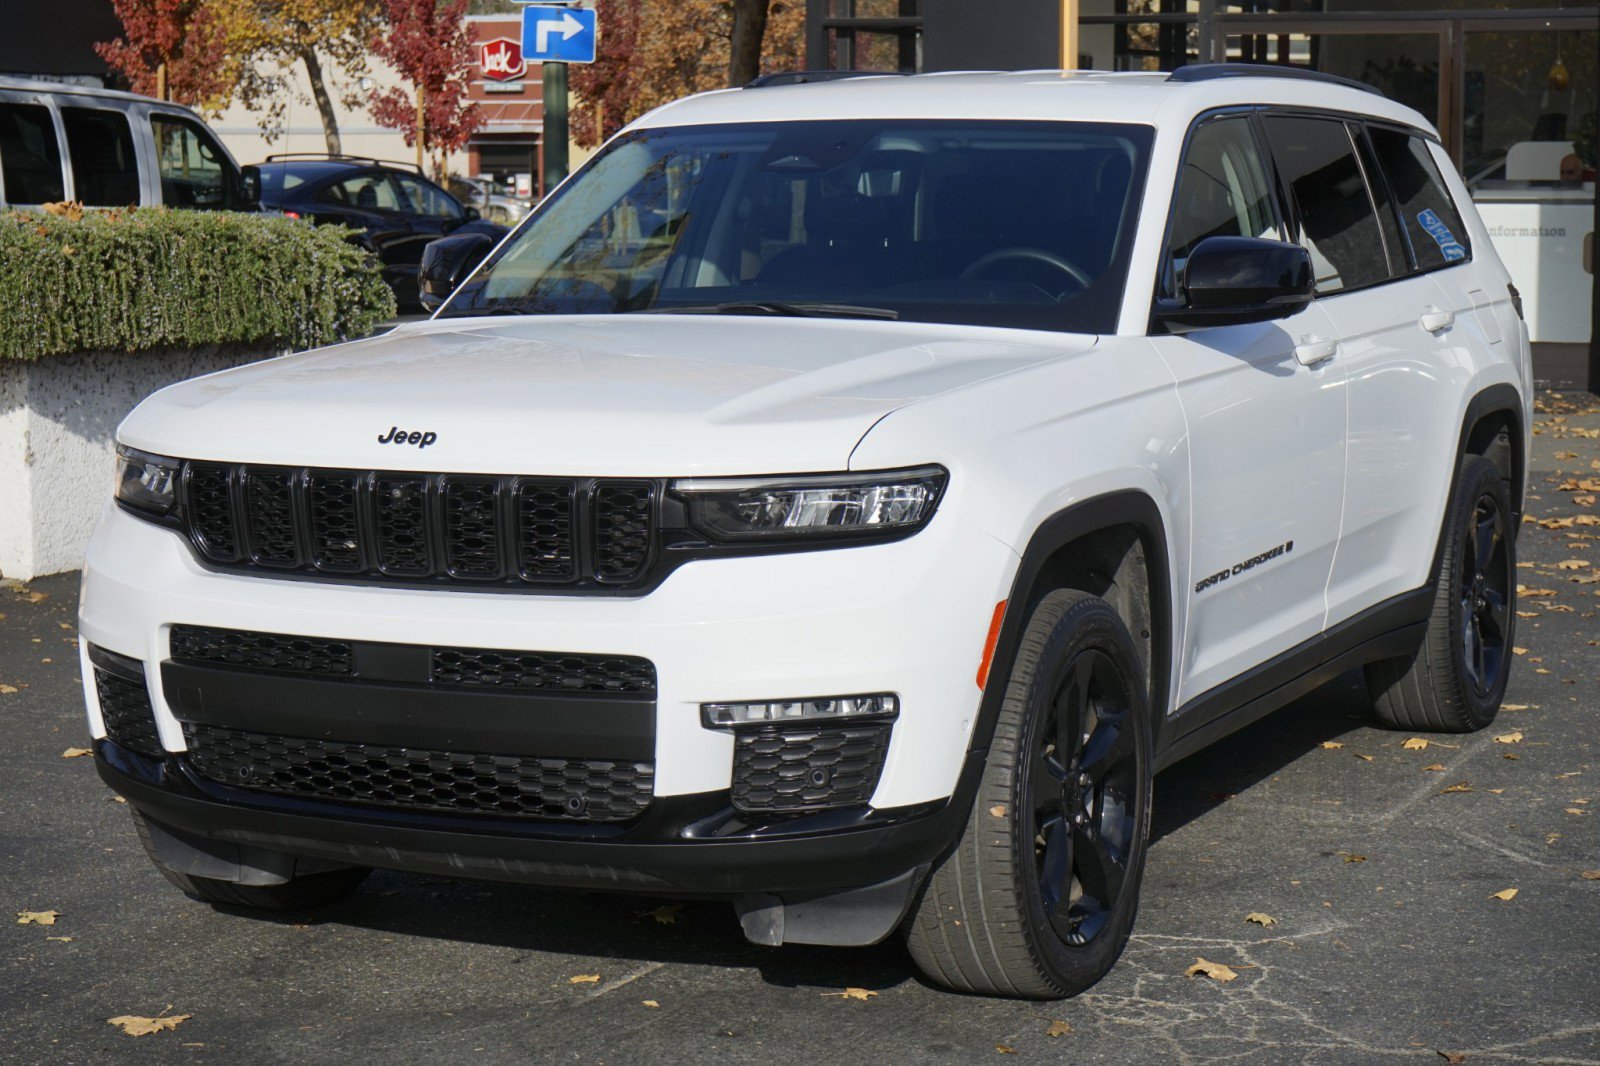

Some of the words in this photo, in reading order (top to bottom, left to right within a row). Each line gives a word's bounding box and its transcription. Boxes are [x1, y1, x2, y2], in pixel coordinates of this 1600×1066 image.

[482, 42, 522, 73] Jack
[1488, 225, 1566, 237] nformation
[378, 426, 437, 449] Jeep
[1195, 568, 1231, 593] GRAND
[1231, 543, 1285, 576] CHEROKEE
